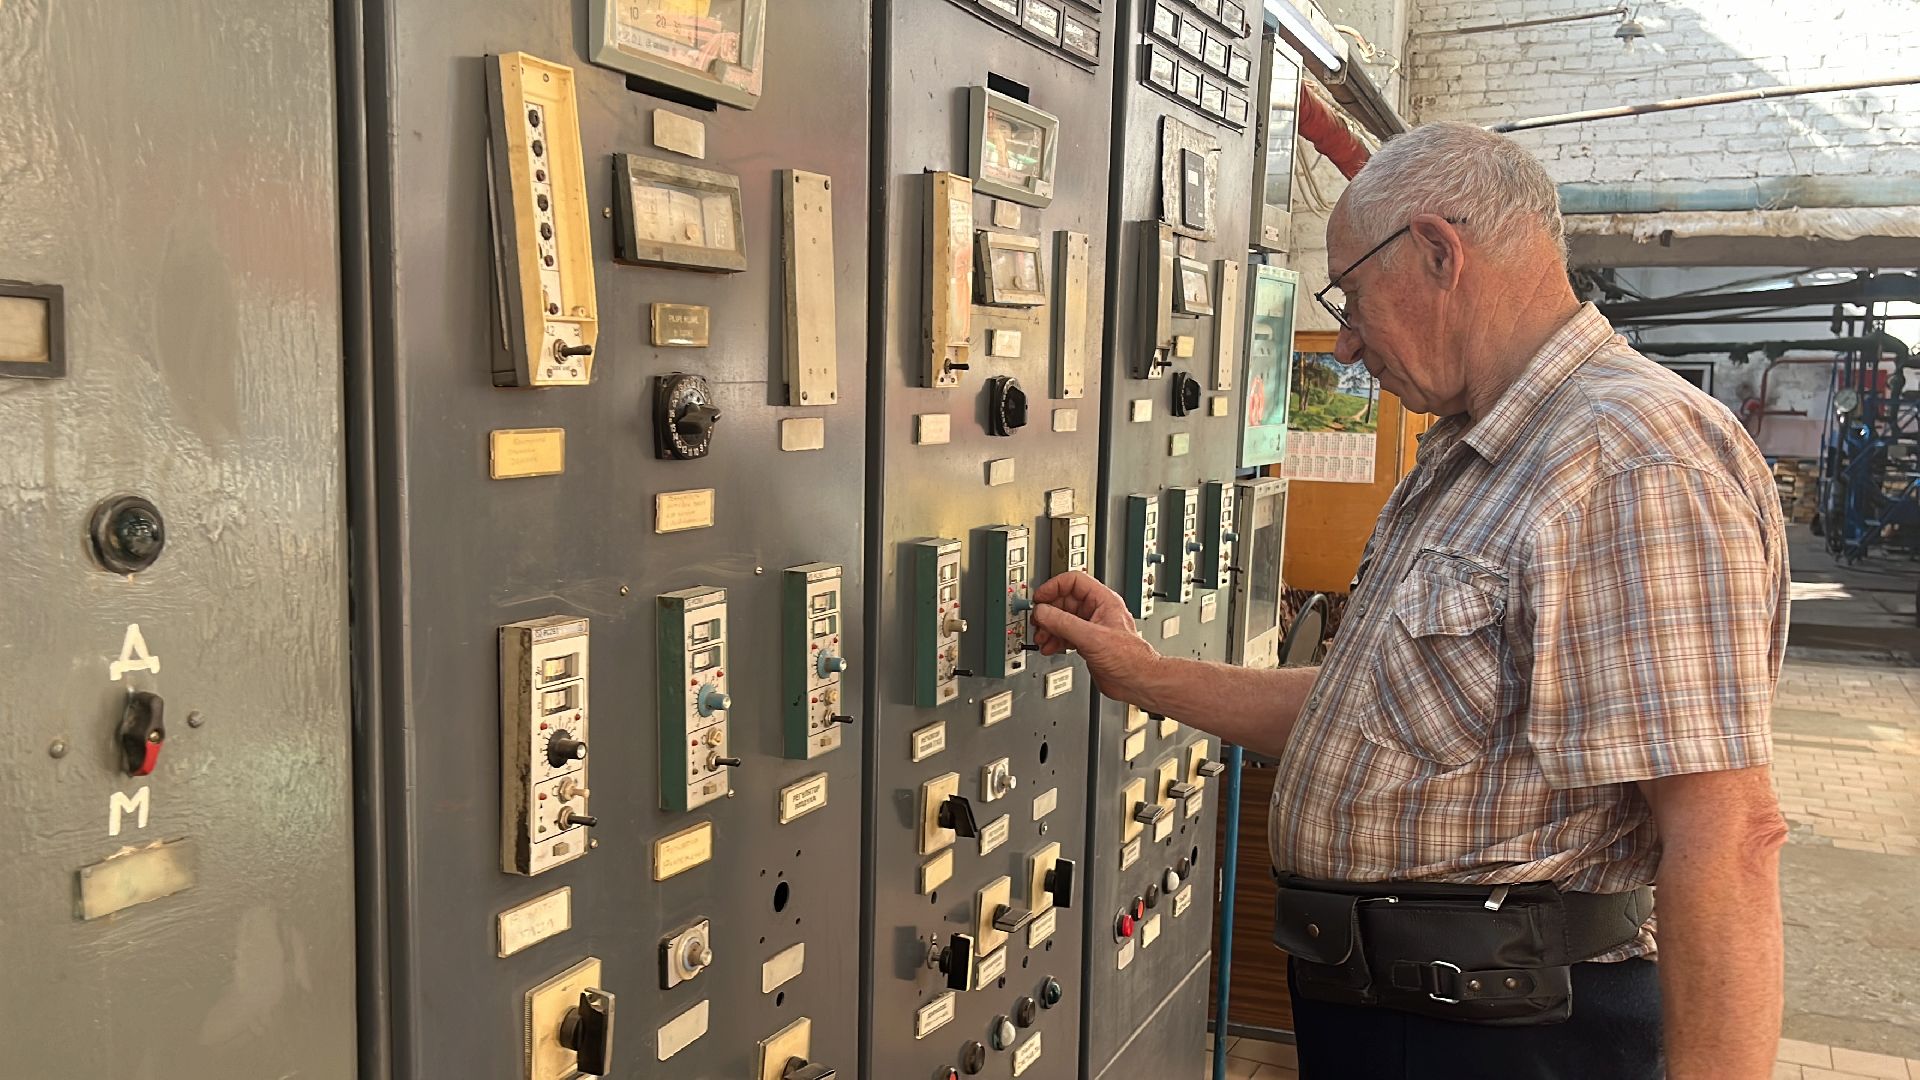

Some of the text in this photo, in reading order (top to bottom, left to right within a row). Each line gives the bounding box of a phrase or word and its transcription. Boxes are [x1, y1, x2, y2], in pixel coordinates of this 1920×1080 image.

[629, 6, 639, 20] 10
[655, 14, 667, 29] 20
[110, 623, 160, 681] Д
[109, 786, 150, 836] М
